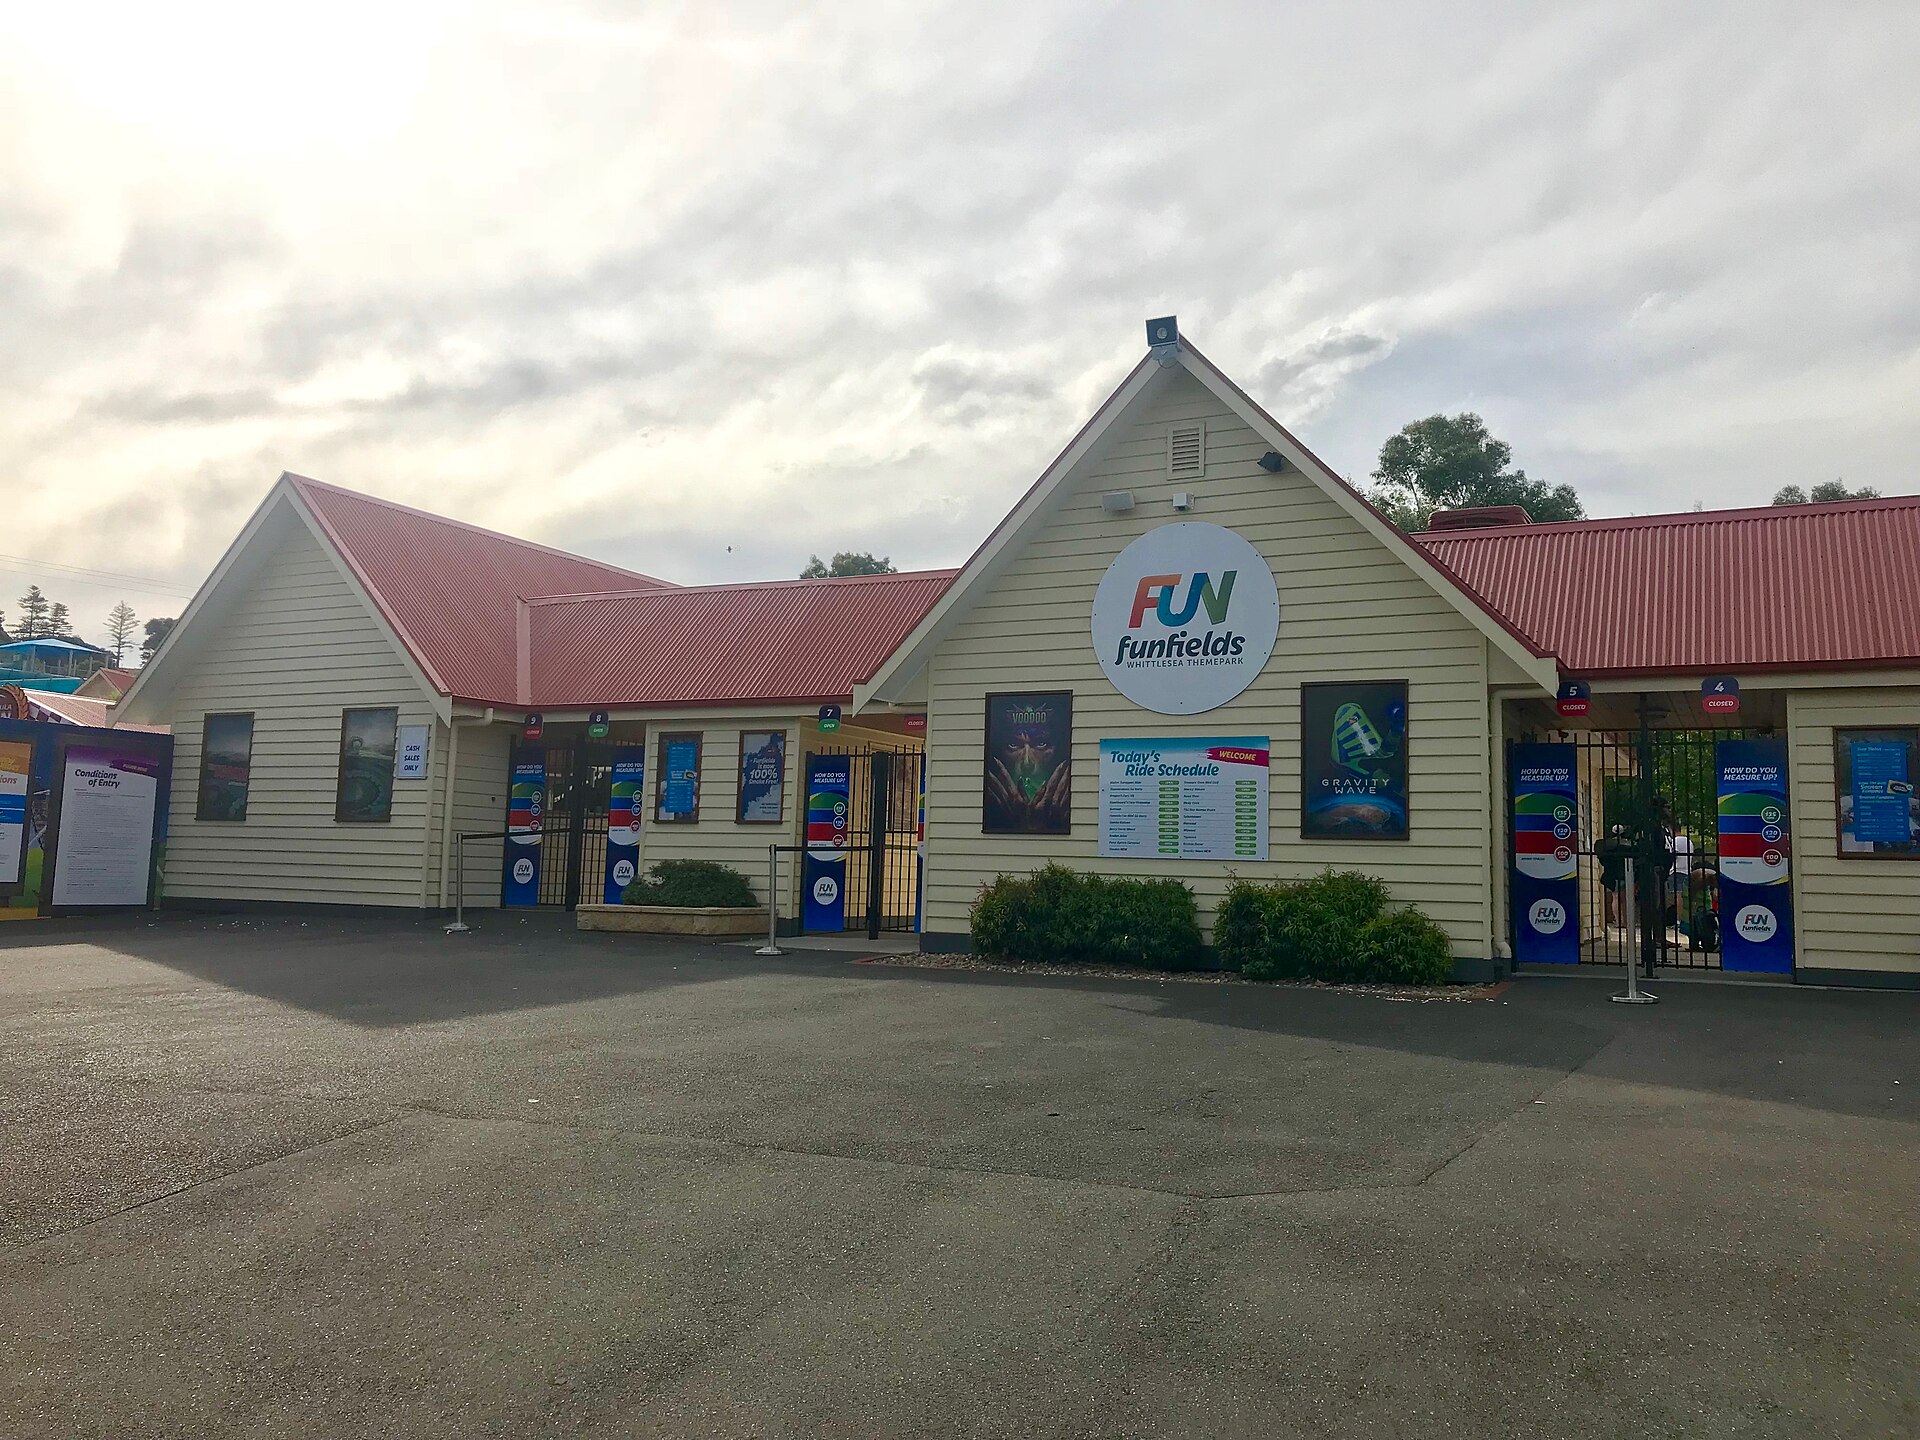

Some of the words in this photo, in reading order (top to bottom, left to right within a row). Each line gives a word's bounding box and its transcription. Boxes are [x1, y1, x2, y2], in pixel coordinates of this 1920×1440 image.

[1128, 570, 1238, 629] FUN
[1114, 630, 1246, 666] funfields
[1126, 659, 1184, 669] WHITTLESEA
[1187, 657, 1244, 667] THEMEPARK
[1569, 686, 1578, 696] 5
[1714, 681, 1725, 692] 4
[596, 714, 602, 722] 8
[826, 708, 833, 717] 7
[1012, 711, 1047, 724] VOODOO
[530, 717, 537, 725] 9
[1110, 749, 1161, 765] Today's
[1218, 750, 1257, 761] WELCOME
[74, 768, 118, 780] Conditions
[750, 768, 778, 780] 100%
[1124, 764, 1155, 777] Ride
[1157, 763, 1220, 777] Schedule
[88, 779, 98, 788] of
[98, 779, 120, 789] Entry
[1321, 778, 1390, 787] GRAVITY
[1334, 786, 1377, 794] WAVE
[819, 884, 834, 892] FUN
[1537, 907, 1559, 918] FUN
[1745, 914, 1769, 925] FUN
